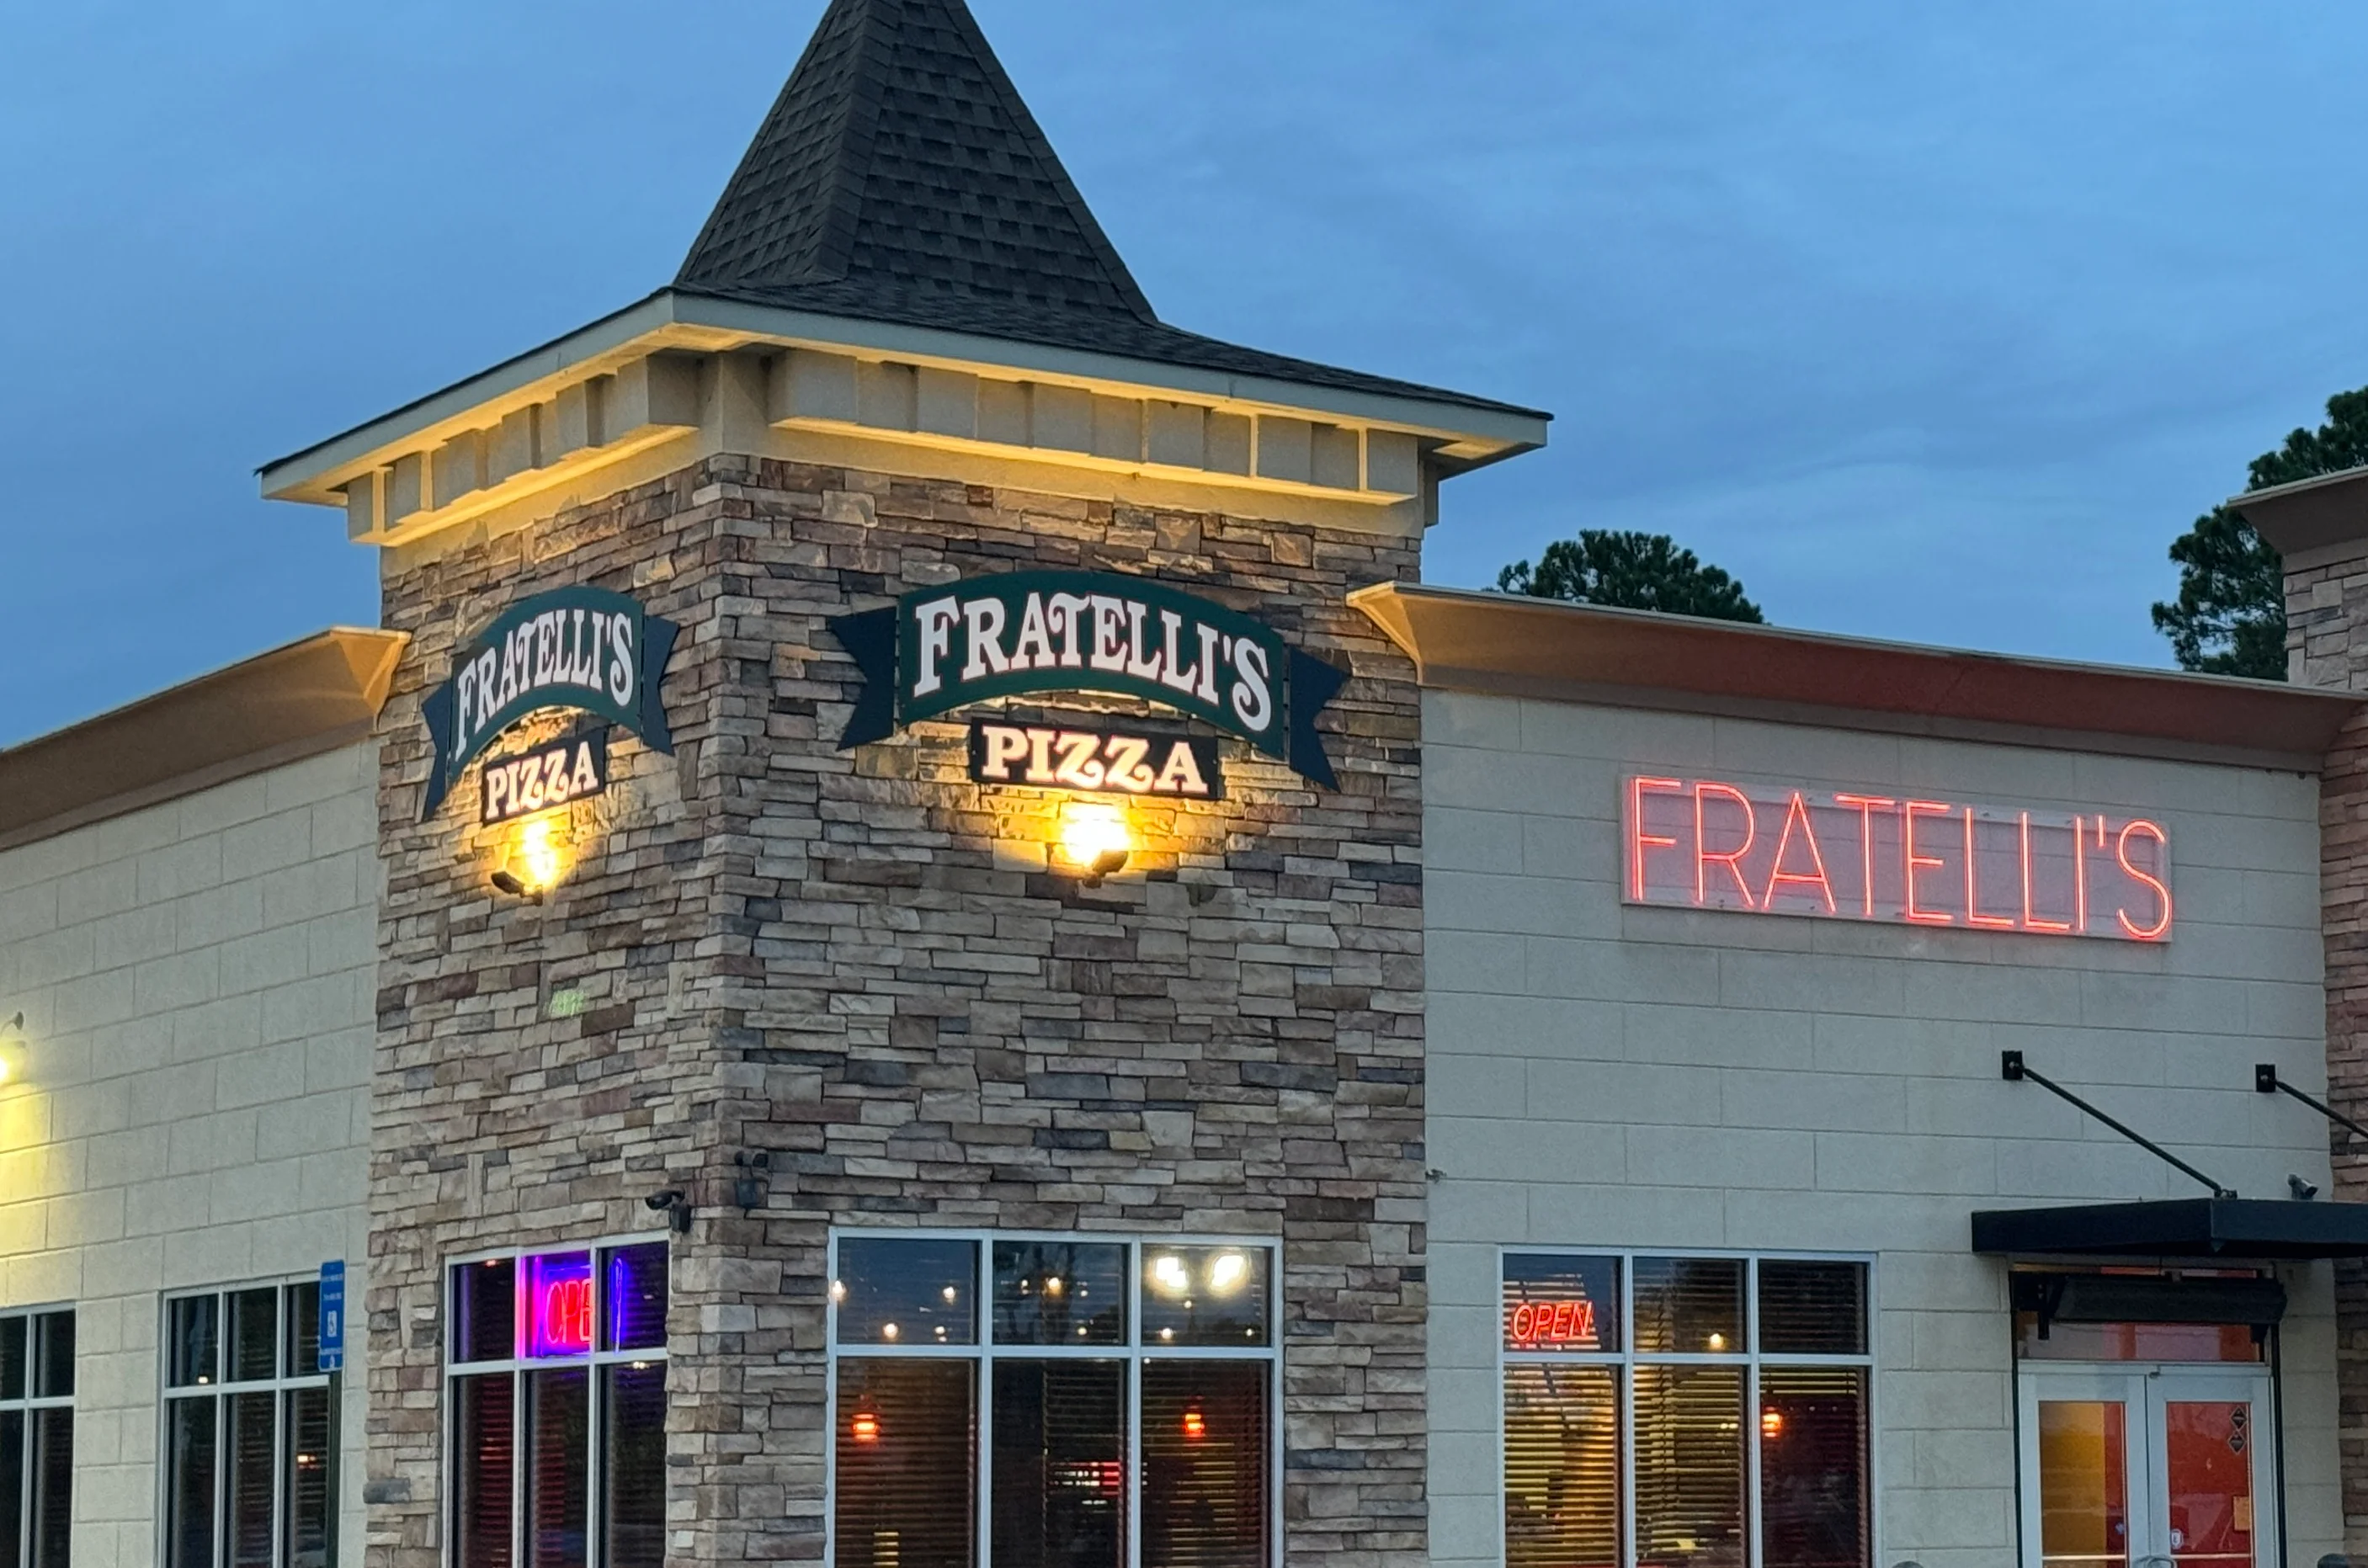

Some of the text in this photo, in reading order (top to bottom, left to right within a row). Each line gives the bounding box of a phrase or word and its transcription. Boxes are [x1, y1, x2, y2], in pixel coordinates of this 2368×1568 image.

[455, 608, 633, 762] FRATELLI'S
[913, 592, 1271, 731] FRATELLI'S
[486, 741, 599, 819] PIZZA
[982, 726, 1207, 794] PIZZA
[1631, 776, 2173, 938] FRATELLI'S
[545, 1278, 593, 1344] OPE
[1514, 1301, 1593, 1341] OPEN
